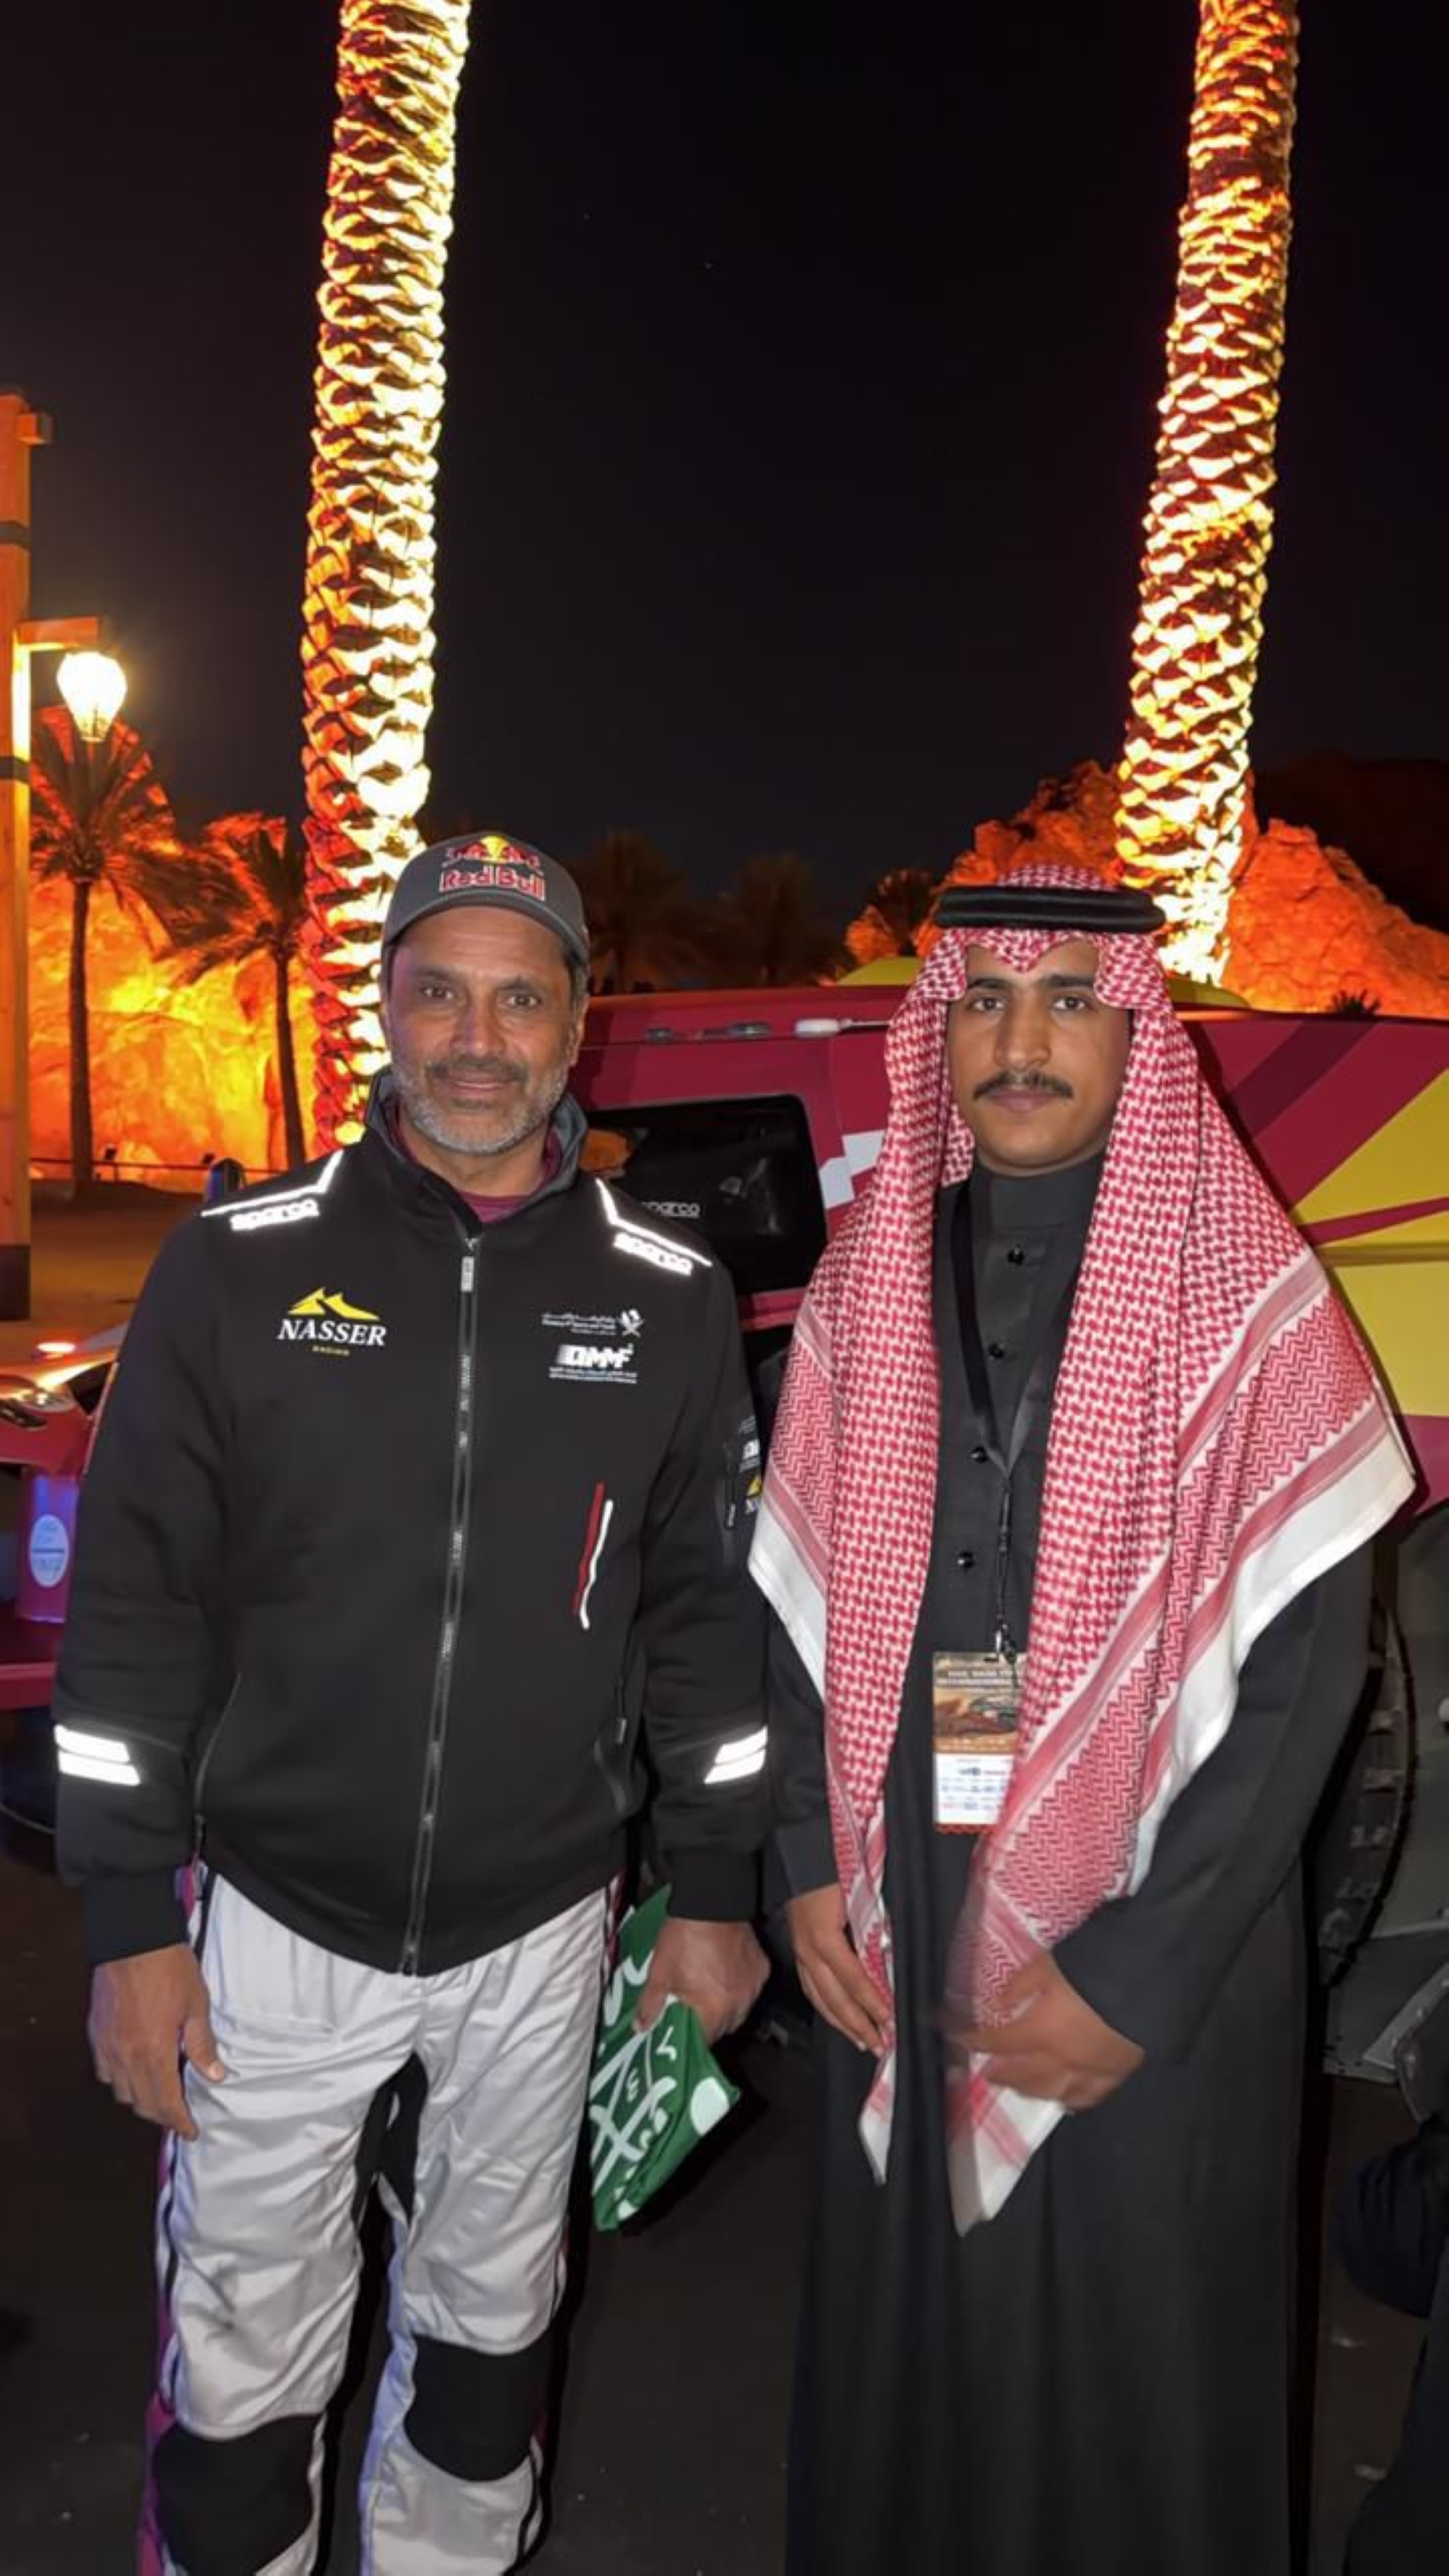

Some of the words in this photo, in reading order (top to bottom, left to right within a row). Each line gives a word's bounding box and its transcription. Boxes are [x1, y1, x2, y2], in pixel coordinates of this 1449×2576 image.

[439, 865, 493, 893] Red
[496, 865, 545, 901] Bull
[277, 1319, 387, 1346] NASSER
